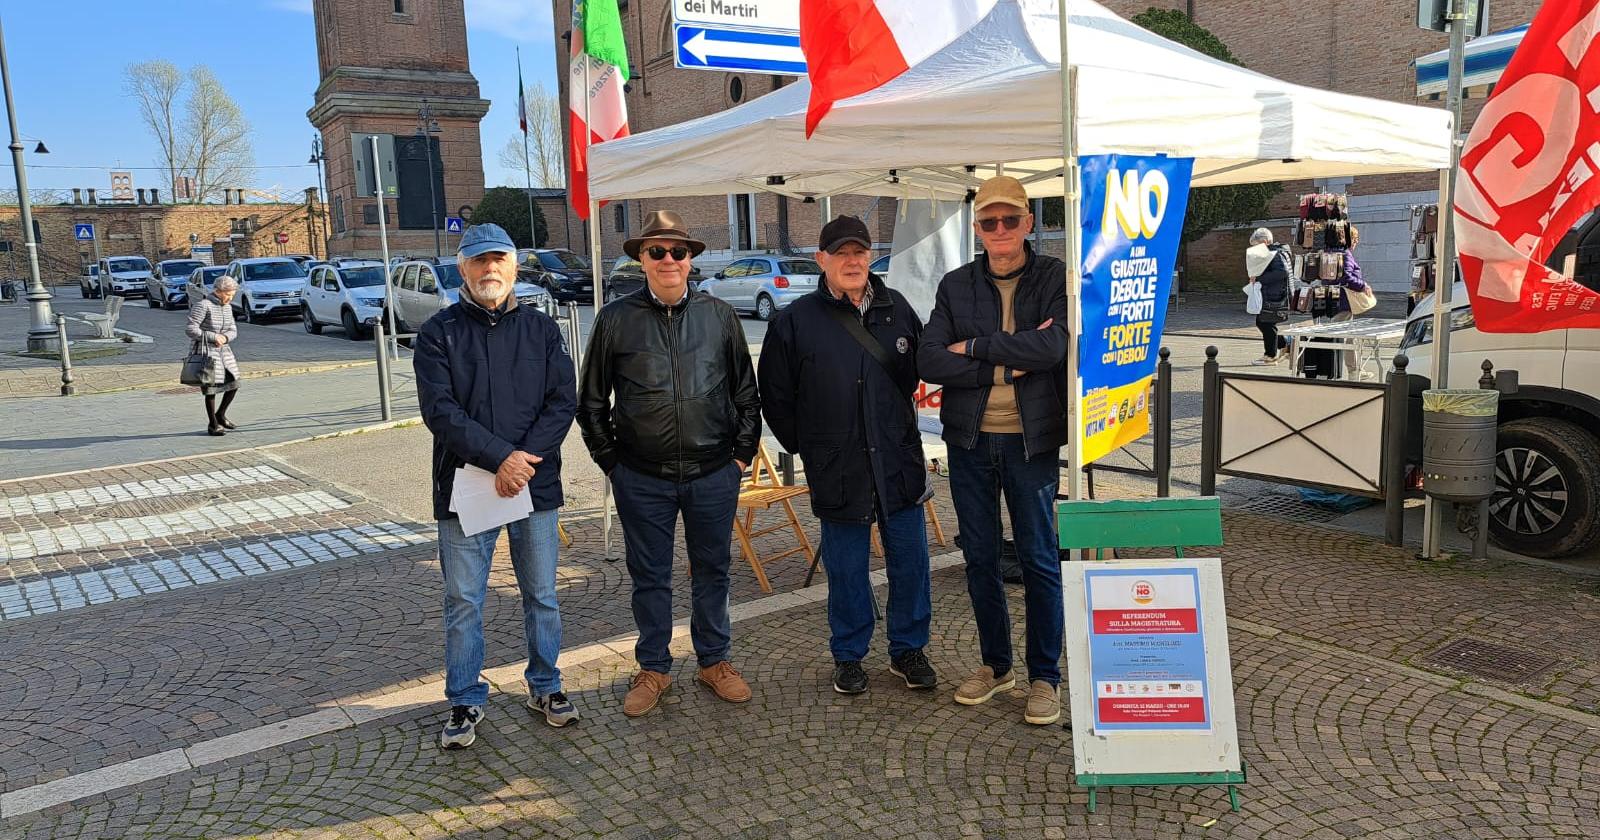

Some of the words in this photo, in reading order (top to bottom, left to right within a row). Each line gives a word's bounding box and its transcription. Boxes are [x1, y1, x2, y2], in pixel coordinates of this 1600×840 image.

[684, 0, 706, 13] dei
[711, 0, 758, 18] Martiri
[1102, 169, 1168, 239] NO
[1129, 246, 1135, 258] A
[1135, 245, 1146, 258] UNA
[1110, 258, 1157, 279] GIUSTIZIA
[1110, 277, 1158, 304] DEBOLE
[1108, 305, 1119, 317] CON
[1120, 300, 1155, 323] FORTI
[1103, 327, 1109, 339] E
[1109, 321, 1152, 349] FORTE
[1102, 350, 1114, 364] CON
[1117, 345, 1149, 366] DEBOLI
[1136, 588, 1150, 596] NO
[1122, 612, 1167, 620] REFERENDUM
[1131, 619, 1181, 627] MAGISTRATURA
